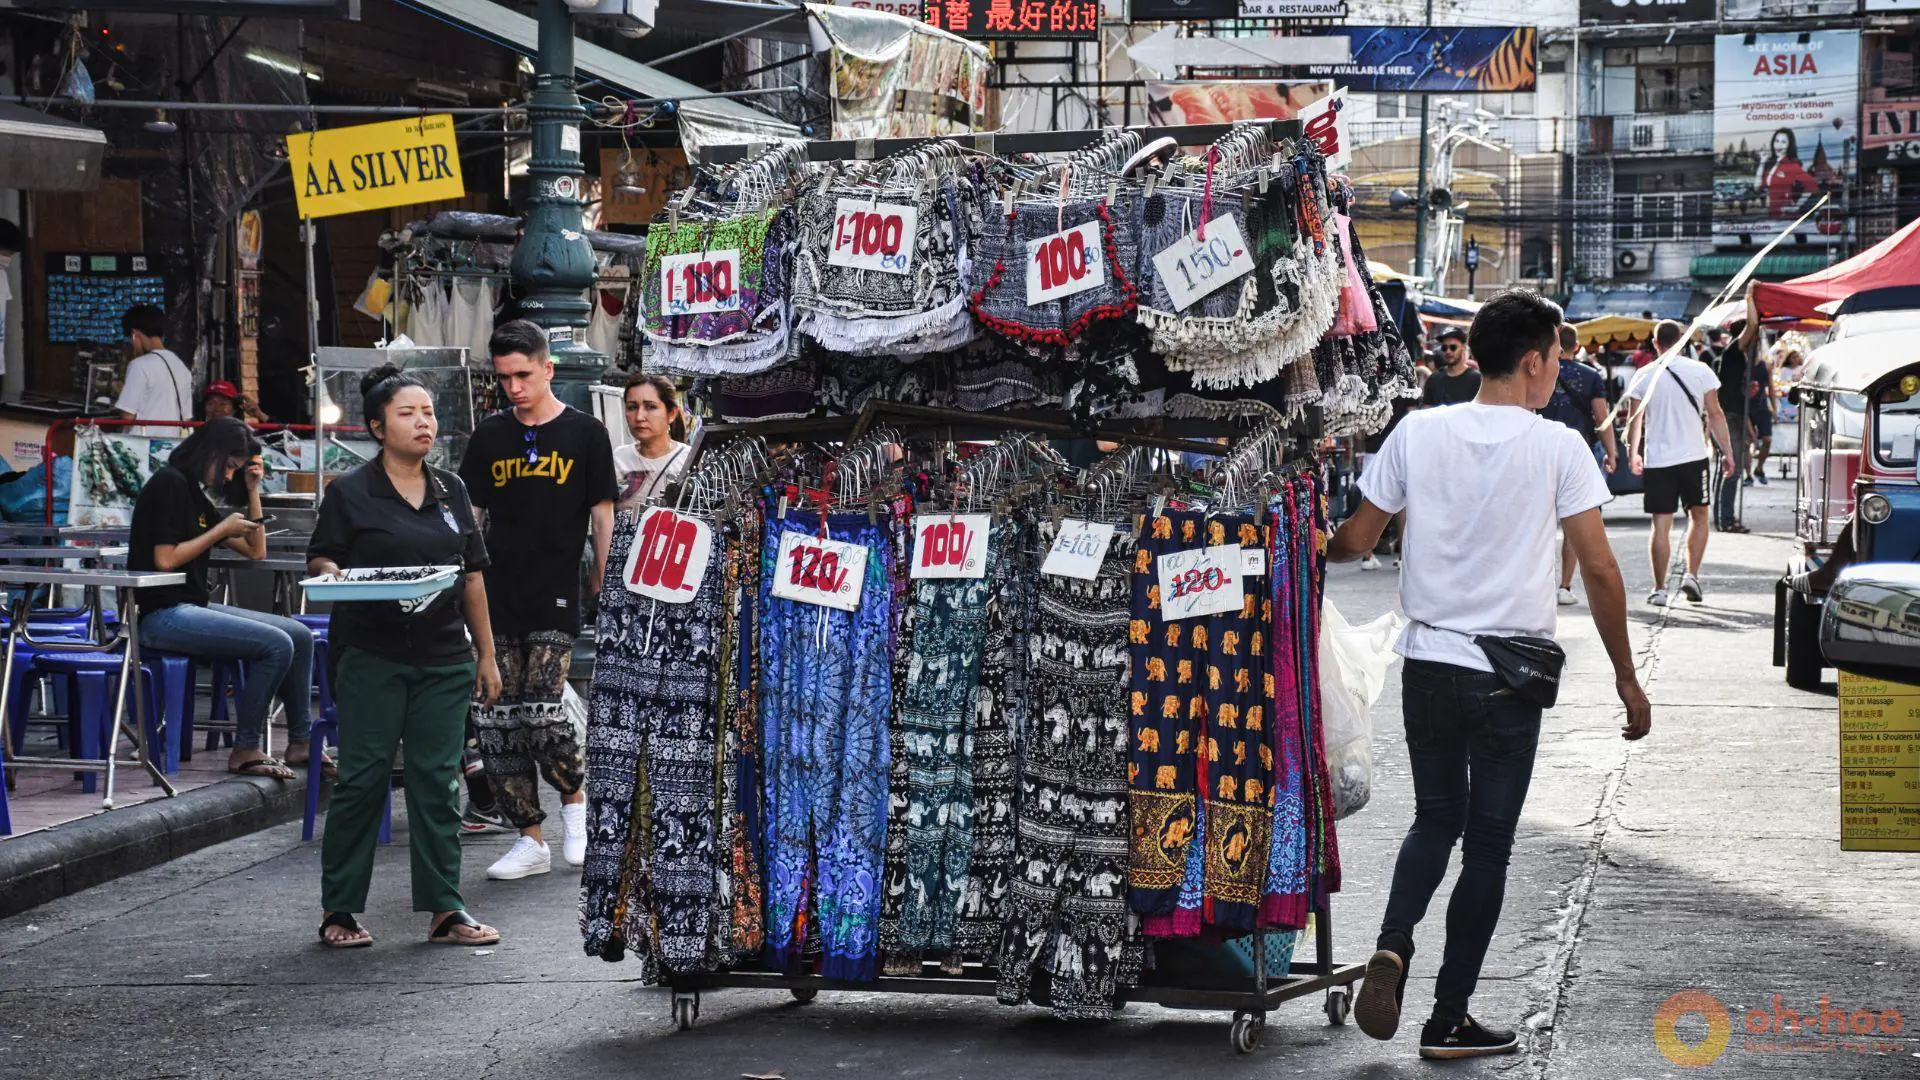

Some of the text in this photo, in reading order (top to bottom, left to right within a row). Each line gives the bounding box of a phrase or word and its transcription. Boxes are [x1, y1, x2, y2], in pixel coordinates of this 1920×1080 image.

[1242, 4, 1342, 14] BAR & RESTAURANT
[1753, 53, 1817, 75] ASIA
[1309, 65, 1415, 75] NOW AVAILABLE HERE.
[1794, 100, 1834, 109] Vietnam
[1746, 111, 1823, 121] Cambodia Laos
[304, 144, 454, 197] AA SILVER
[491, 450, 574, 487] grizzly
[1519, 665, 1529, 674] All
[1530, 669, 1543, 678] you
[1843, 697, 1894, 707] Thai Oil Massage
[1842, 733, 1857, 741] Back
[1860, 733, 1873, 741] Neck
[1883, 733, 1913, 741] Shoulders
[1844, 769, 1896, 778] Therapy Massage
[1866, 805, 1897, 816] (Swedish)
